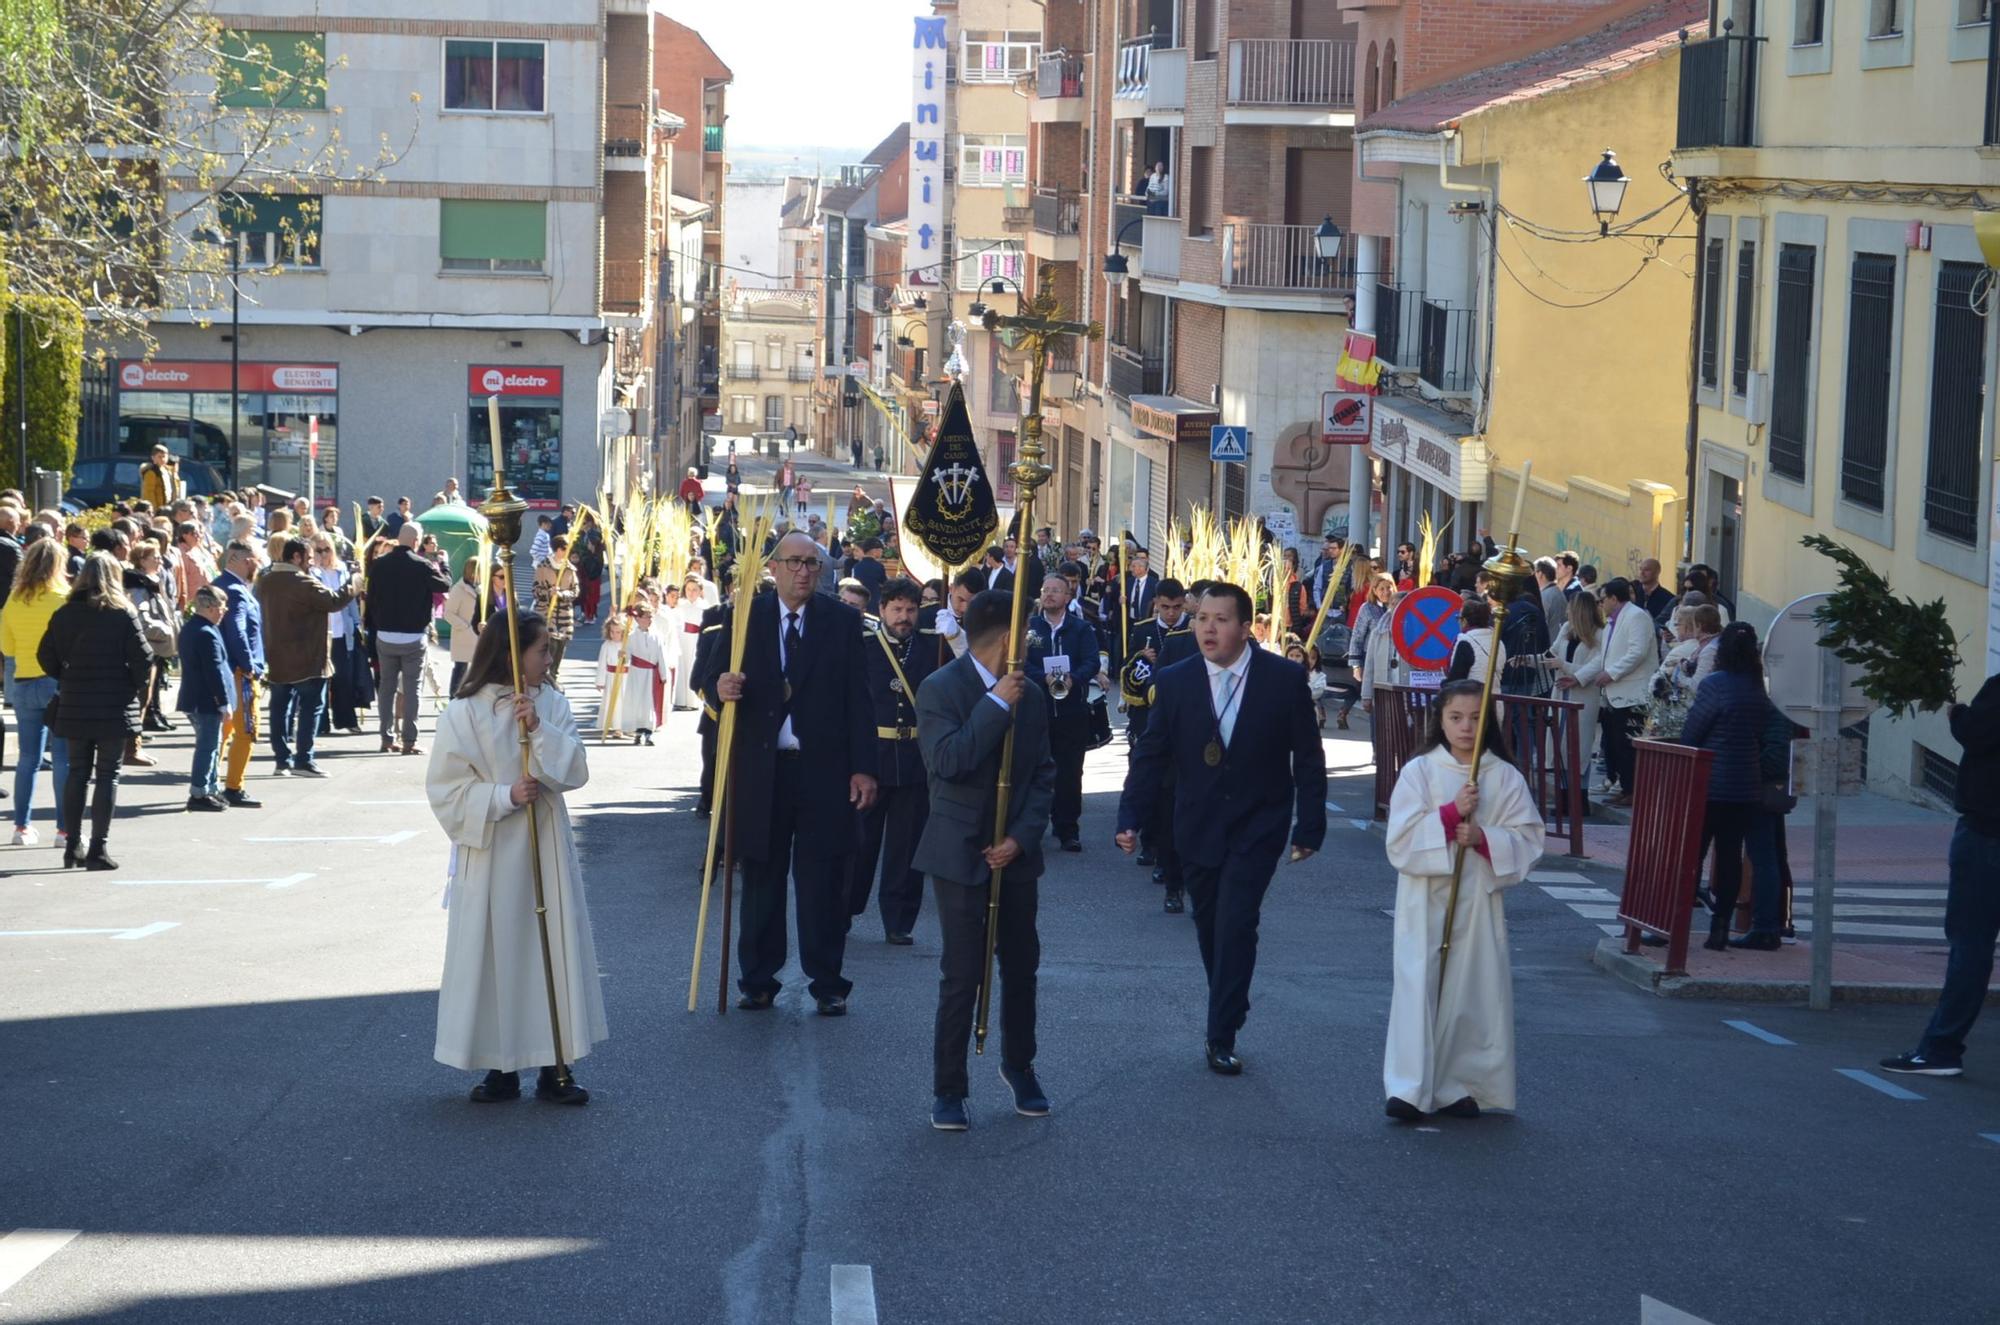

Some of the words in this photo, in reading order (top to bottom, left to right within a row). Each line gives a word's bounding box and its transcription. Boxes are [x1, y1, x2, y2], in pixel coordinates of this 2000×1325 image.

[913, 15, 947, 250] Minuit
[125, 369, 141, 381] mi
[145, 368, 189, 382] electro
[283, 370, 321, 378] ELECTRO
[486, 375, 500, 385] mi
[504, 374, 548, 387] electro
[283, 378, 334, 387] BENAVENTE
[928, 533, 940, 544] EL
[940, 532, 981, 546] CALVARIO
